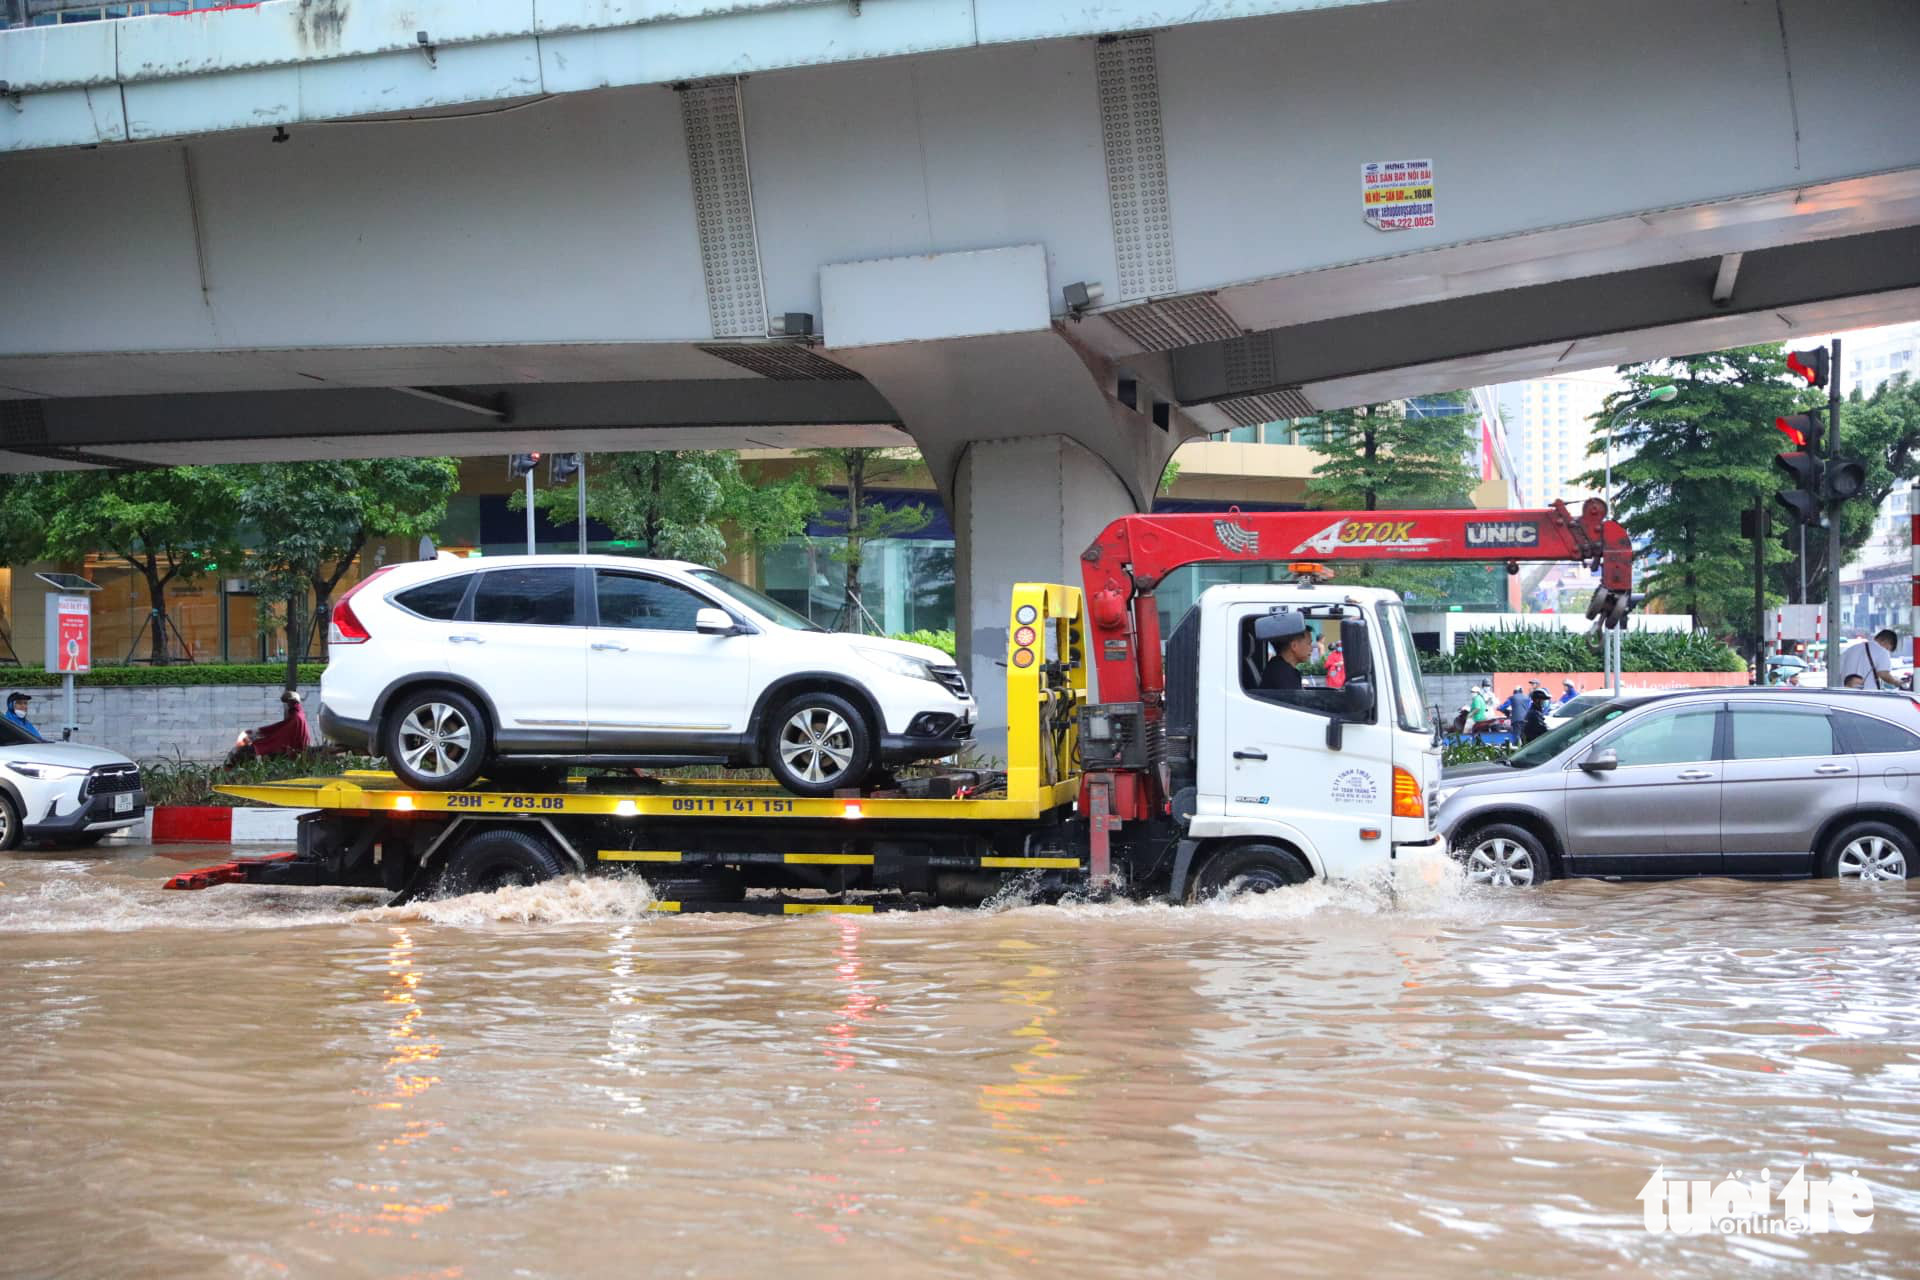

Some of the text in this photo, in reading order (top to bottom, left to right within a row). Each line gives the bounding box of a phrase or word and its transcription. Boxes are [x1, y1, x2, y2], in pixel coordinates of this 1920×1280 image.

[1467, 526, 1537, 543] UNIC
[447, 795, 482, 807] 29H
[502, 796, 563, 809] 783.08
[672, 799, 793, 812] 0911 141 151
